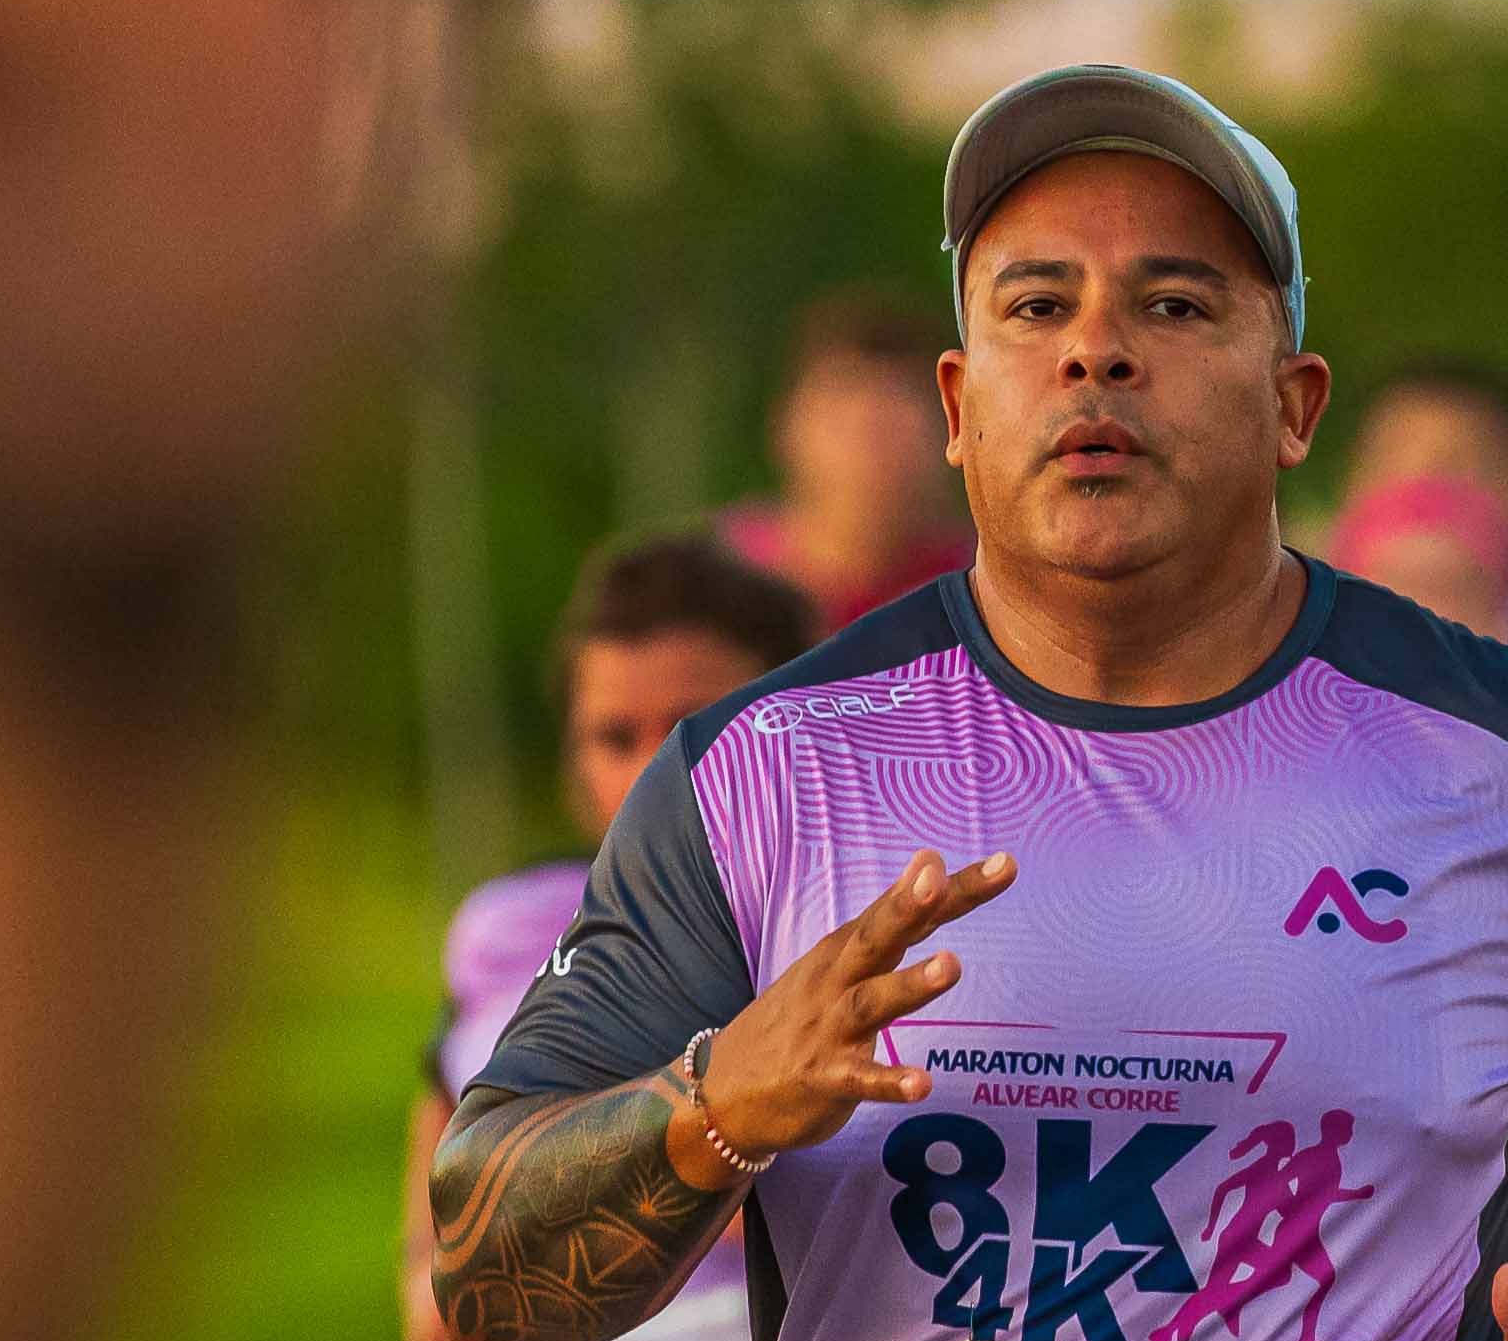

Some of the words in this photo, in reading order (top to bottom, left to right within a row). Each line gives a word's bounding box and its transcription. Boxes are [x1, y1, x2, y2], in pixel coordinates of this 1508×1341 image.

[925, 1048, 1065, 1077] MARATON
[1074, 1054, 1235, 1083] NOCTURNA
[972, 1082, 1078, 1109] ALVEAR
[1086, 1087, 1181, 1113] CORRE
[881, 1112, 1218, 1294] 8K
